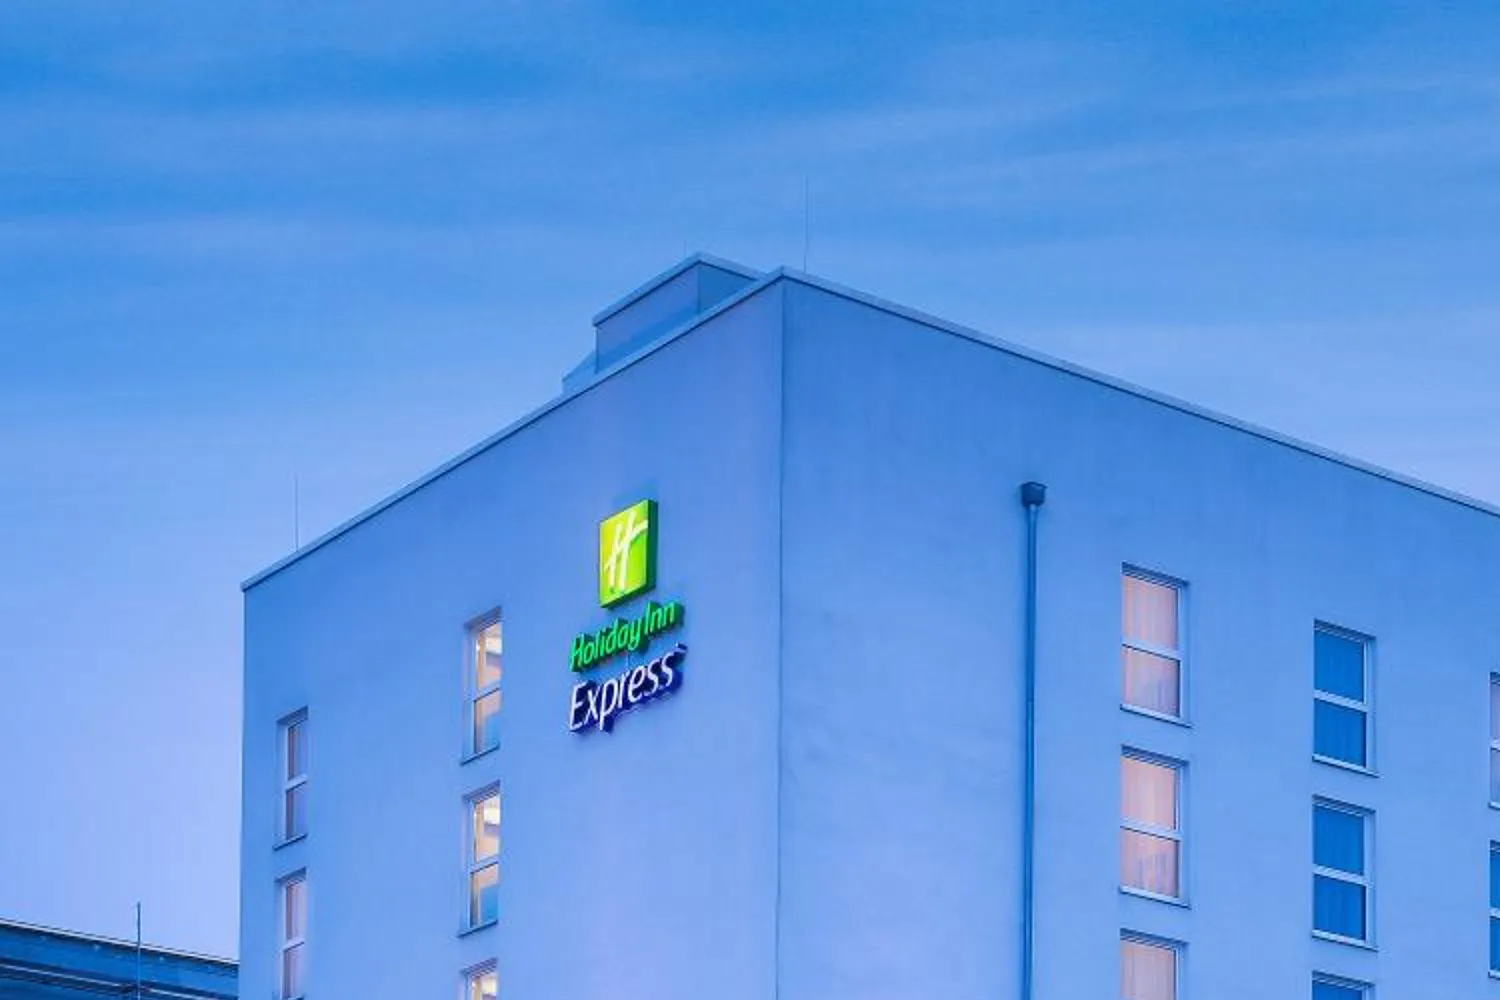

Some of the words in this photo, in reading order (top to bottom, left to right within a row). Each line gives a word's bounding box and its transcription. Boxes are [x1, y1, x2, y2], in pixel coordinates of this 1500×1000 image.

[569, 618, 643, 671] Holiday
[643, 600, 679, 637] Inn
[569, 651, 679, 731] Express
